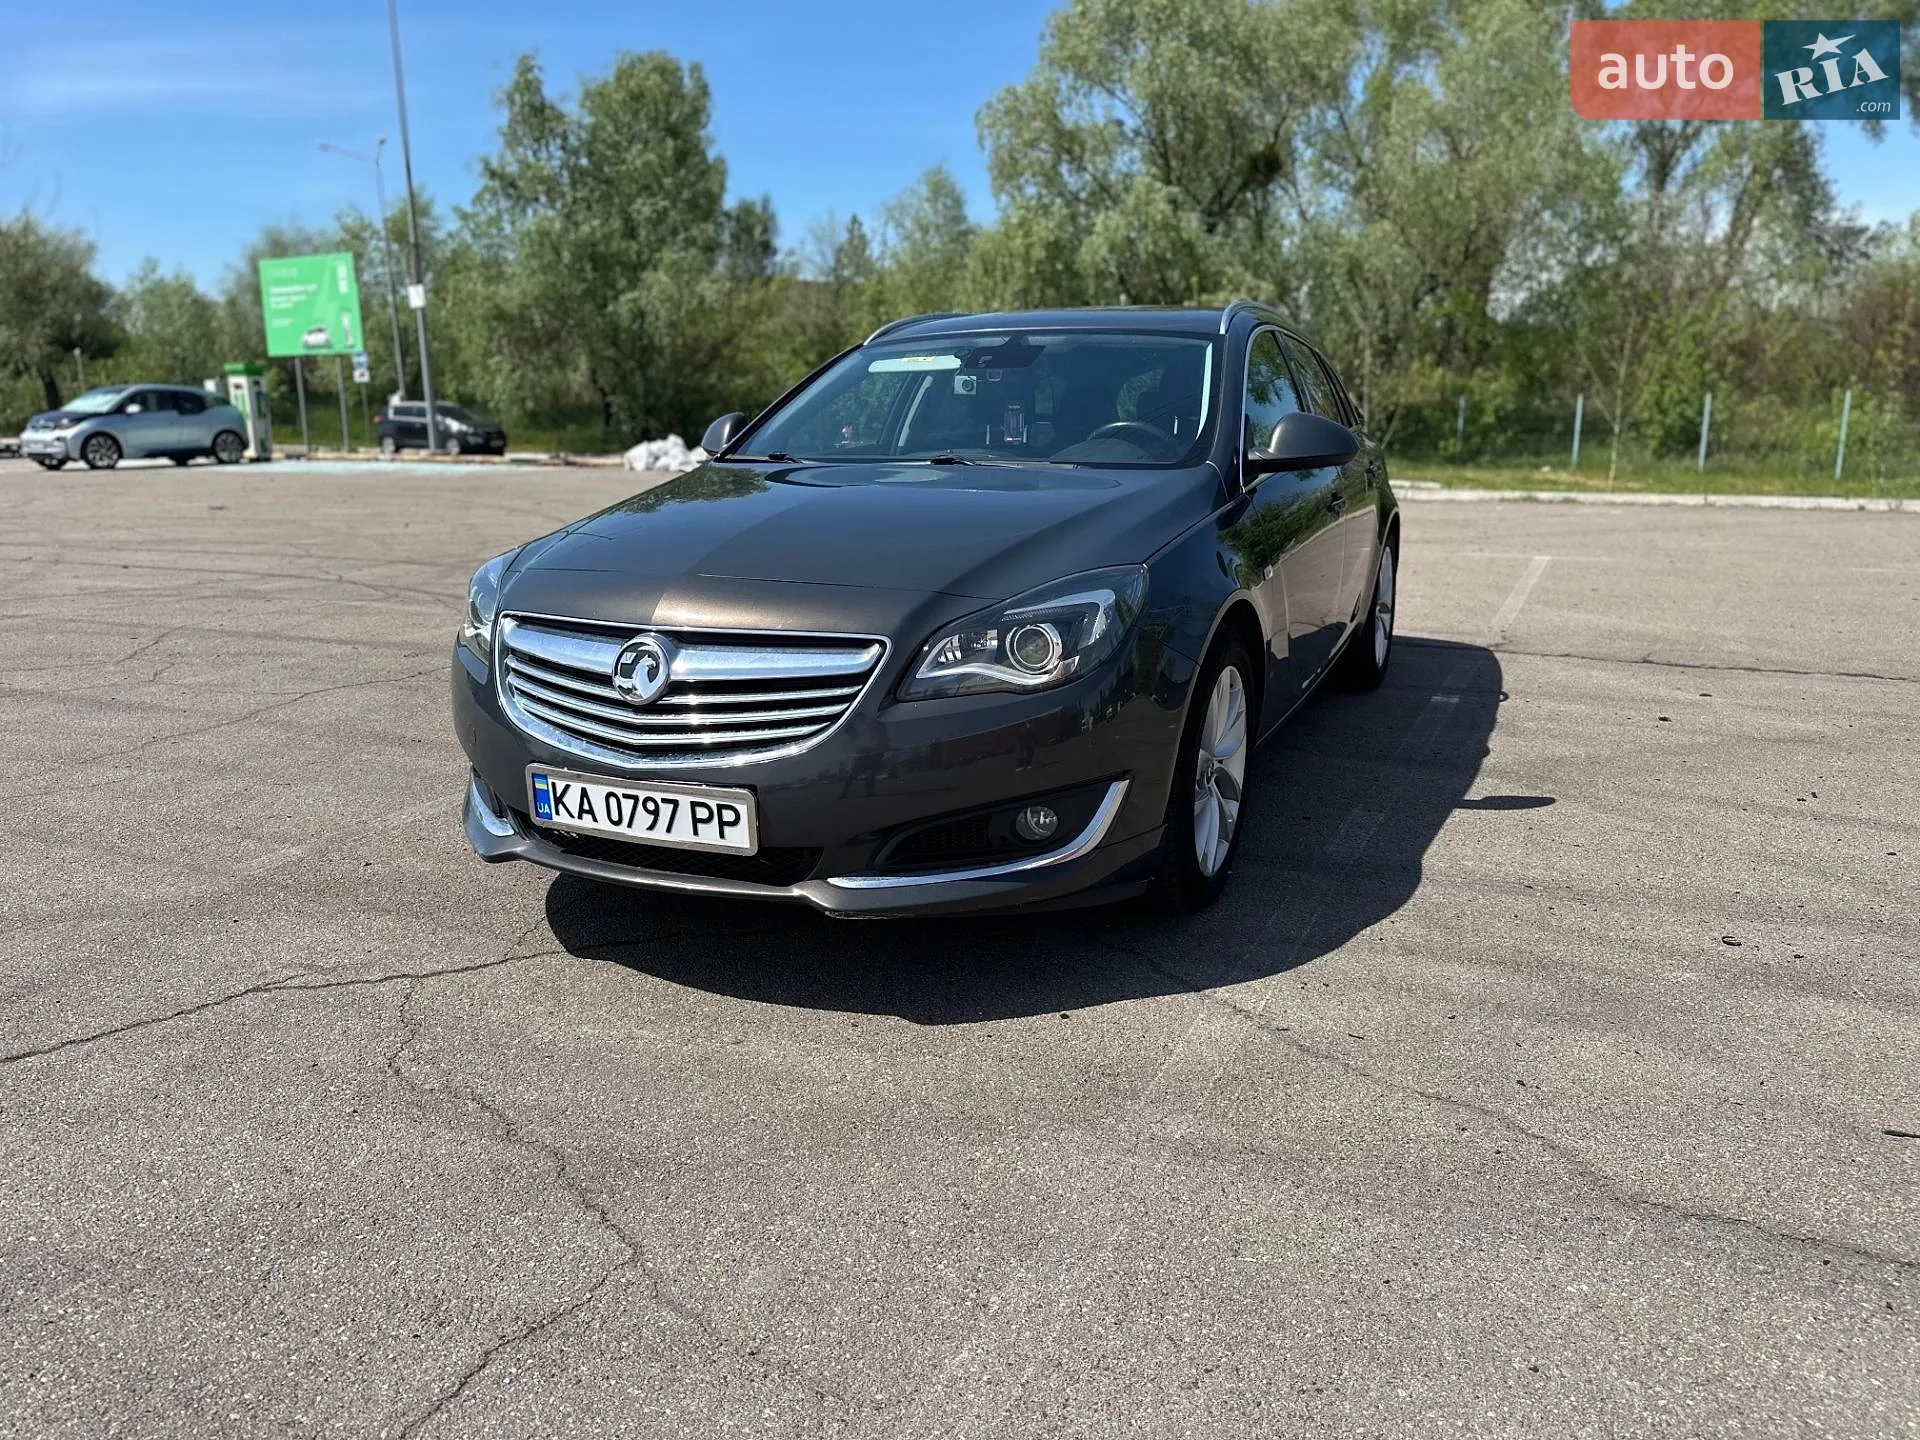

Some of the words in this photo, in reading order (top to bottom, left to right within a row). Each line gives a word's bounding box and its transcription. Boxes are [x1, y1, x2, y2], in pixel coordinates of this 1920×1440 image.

[537, 803, 551, 815] UA
[551, 781, 599, 823] KA
[605, 791, 680, 834] 0797
[689, 800, 741, 839] PP
